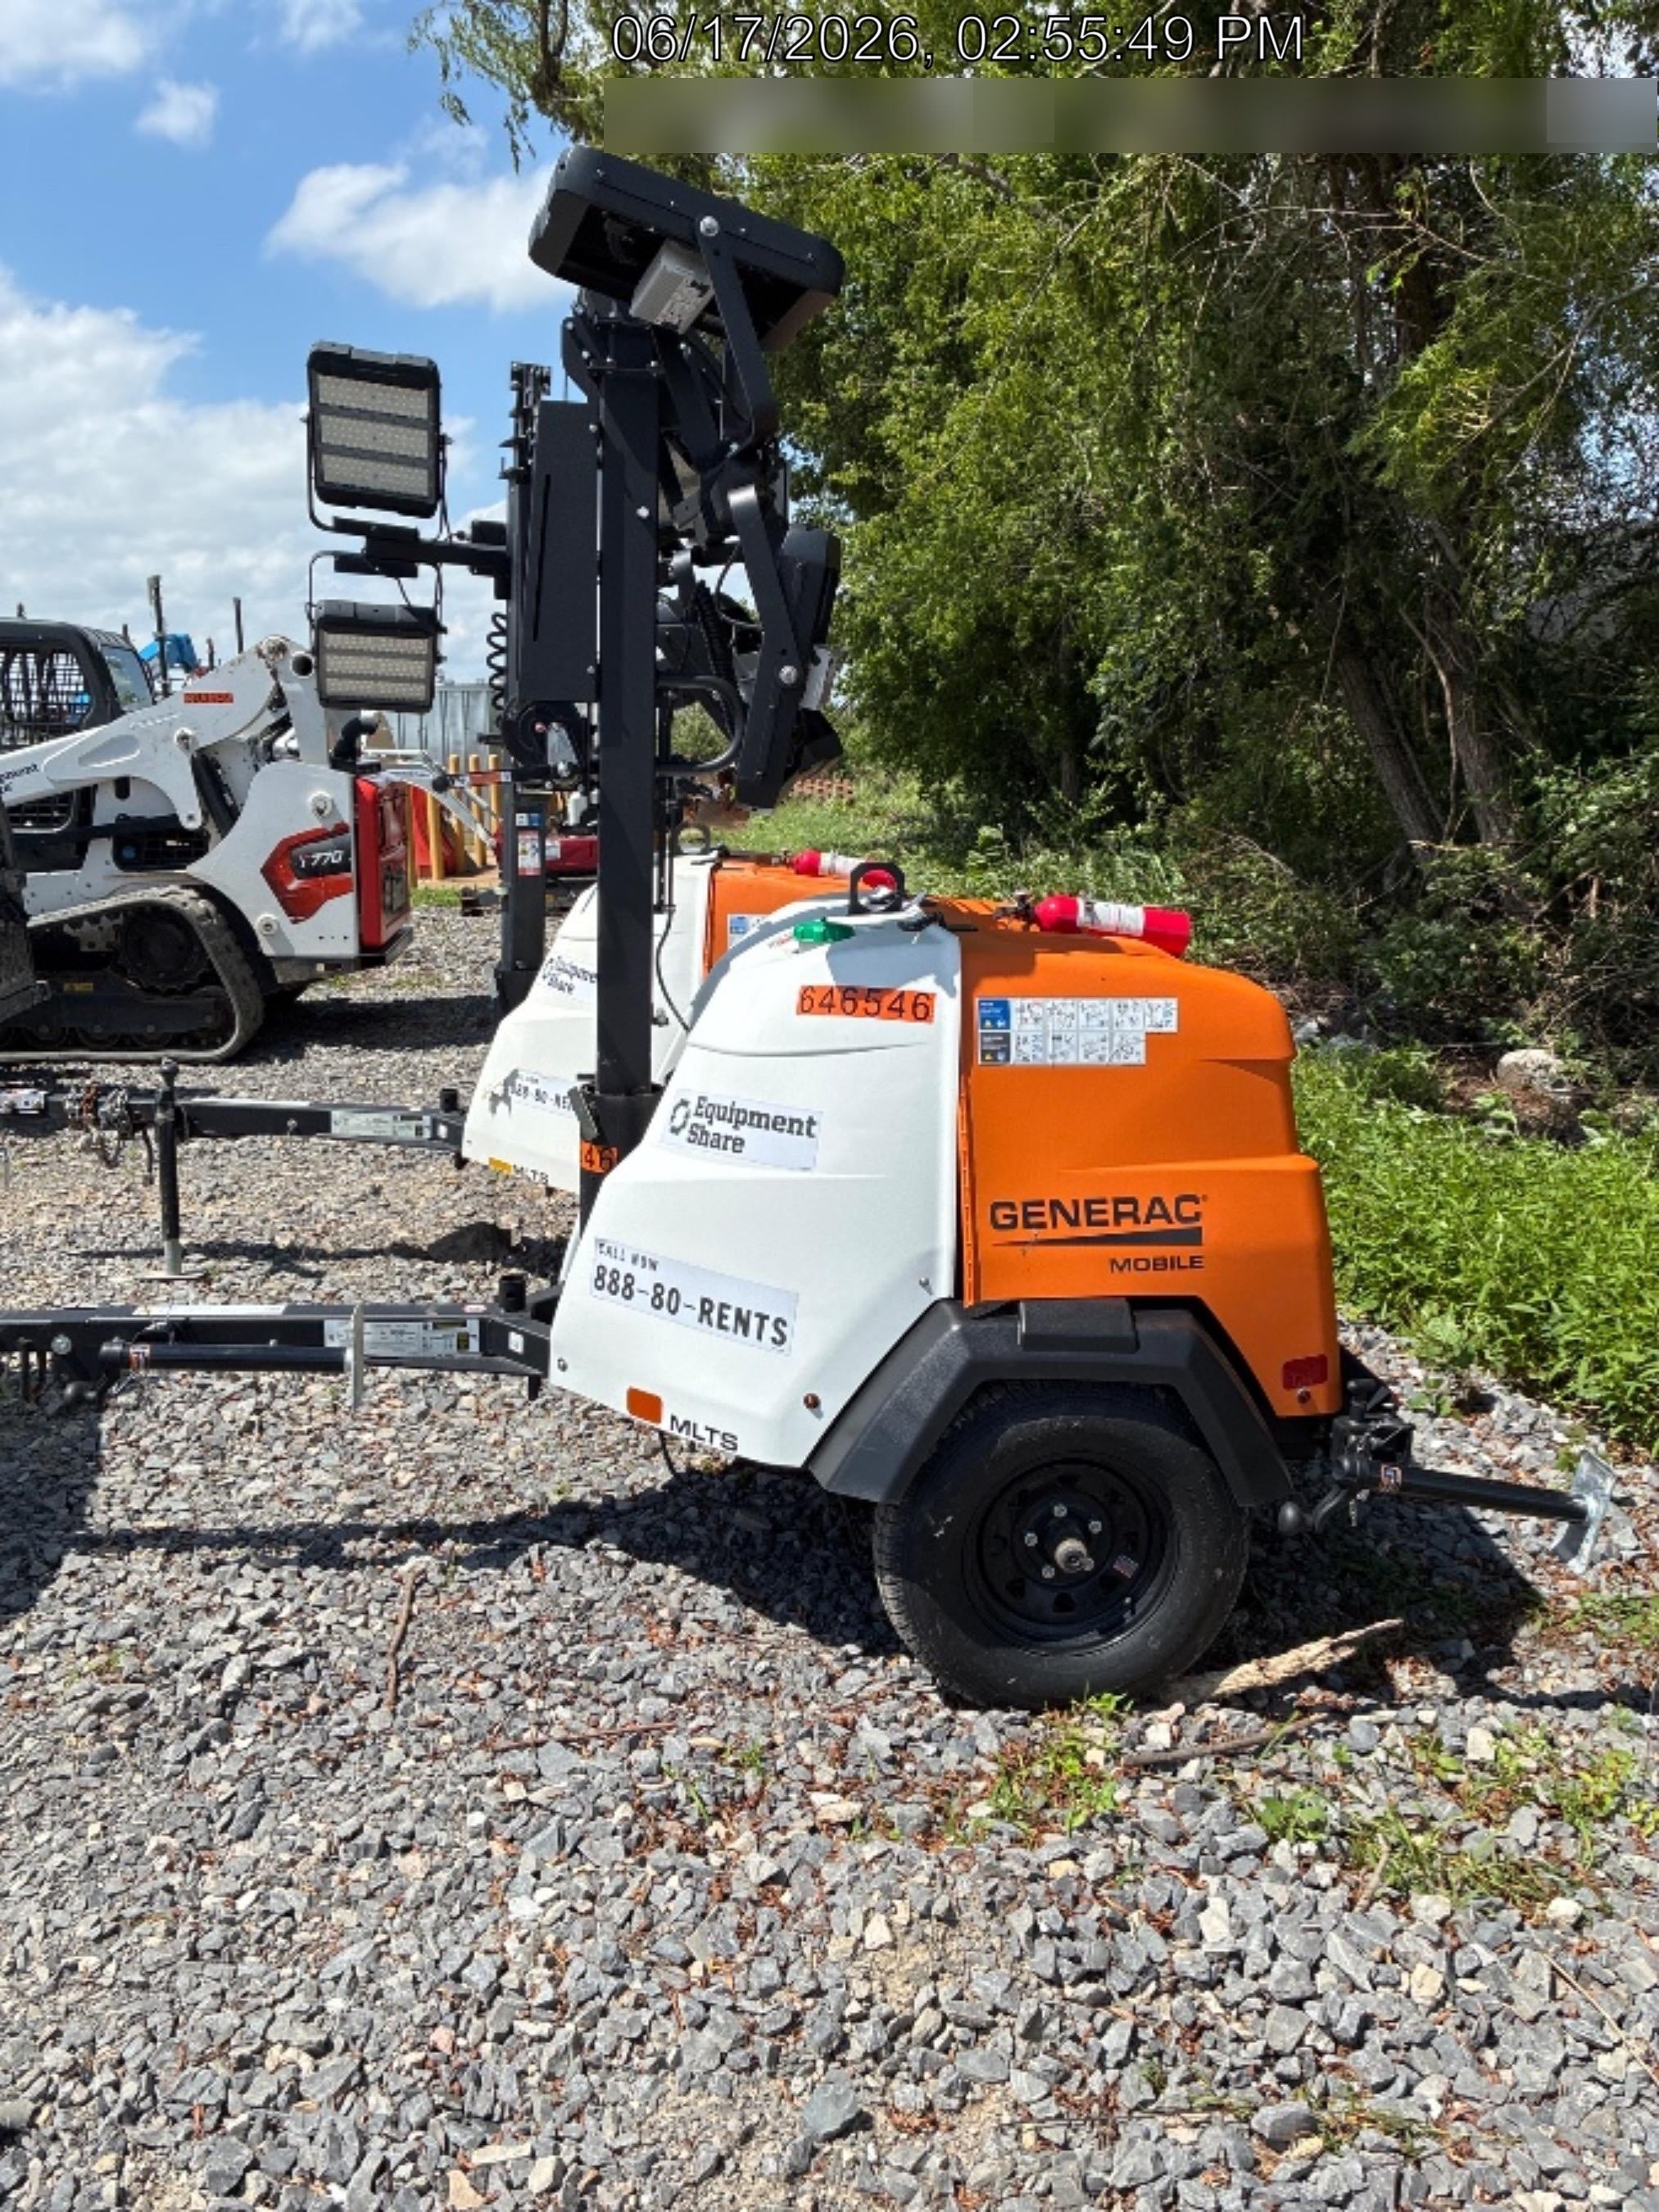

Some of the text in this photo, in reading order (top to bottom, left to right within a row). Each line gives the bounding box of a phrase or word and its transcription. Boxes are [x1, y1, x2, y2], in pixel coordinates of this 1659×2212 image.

[799, 985, 931, 1021] 646546
[693, 1095, 817, 1139] Equipment
[687, 1122, 746, 1154] Share
[990, 1194, 1201, 1230] GENERAC
[1110, 1255, 1205, 1273] MOBILE
[593, 1264, 788, 1347] 888-80-RENTS
[670, 1413, 738, 1451] MLTS
